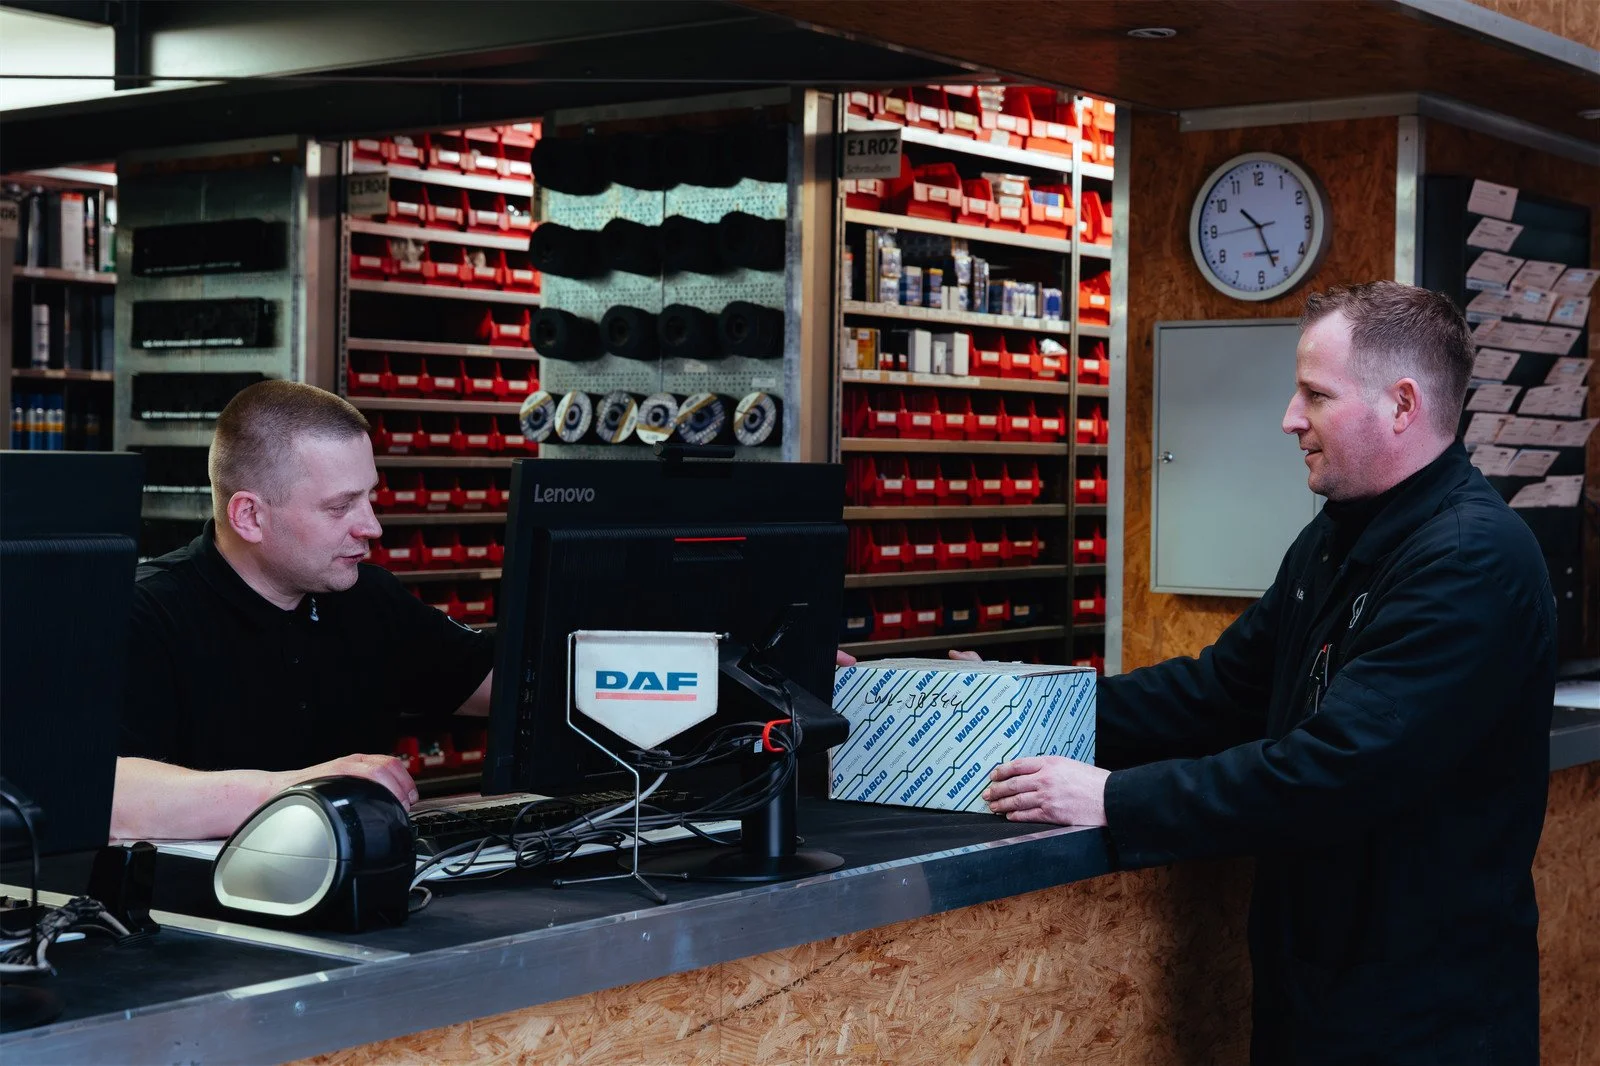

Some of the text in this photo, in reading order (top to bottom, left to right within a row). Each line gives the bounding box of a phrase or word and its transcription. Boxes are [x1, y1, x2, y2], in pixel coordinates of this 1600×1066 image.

[847, 138, 898, 156] E1R02
[1253, 171, 1264, 186] 12
[1279, 175, 1284, 190] 1
[1231, 180, 1240, 195] 11
[1295, 190, 1303, 205] 2
[1216, 199, 1227, 213] 10
[1304, 215, 1312, 230] 3
[1210, 225, 1218, 239] 9
[1298, 241, 1305, 256] 4
[1219, 249, 1226, 264] 8
[1234, 270, 1240, 282] 7
[1258, 270, 1265, 285] 6
[1283, 266, 1289, 276] 5
[534, 484, 595, 503] Lenovo
[596, 671, 698, 691] DAF
[1070, 678, 1091, 717] WABCO
[1041, 688, 1062, 728] WABCO
[955, 705, 989, 743] WABCO
[1003, 699, 1033, 739] WABCO
[863, 714, 896, 751] WABCO
[908, 710, 941, 747] WABCO
[900, 766, 933, 803] WABCO
[946, 762, 981, 799] WABCO
